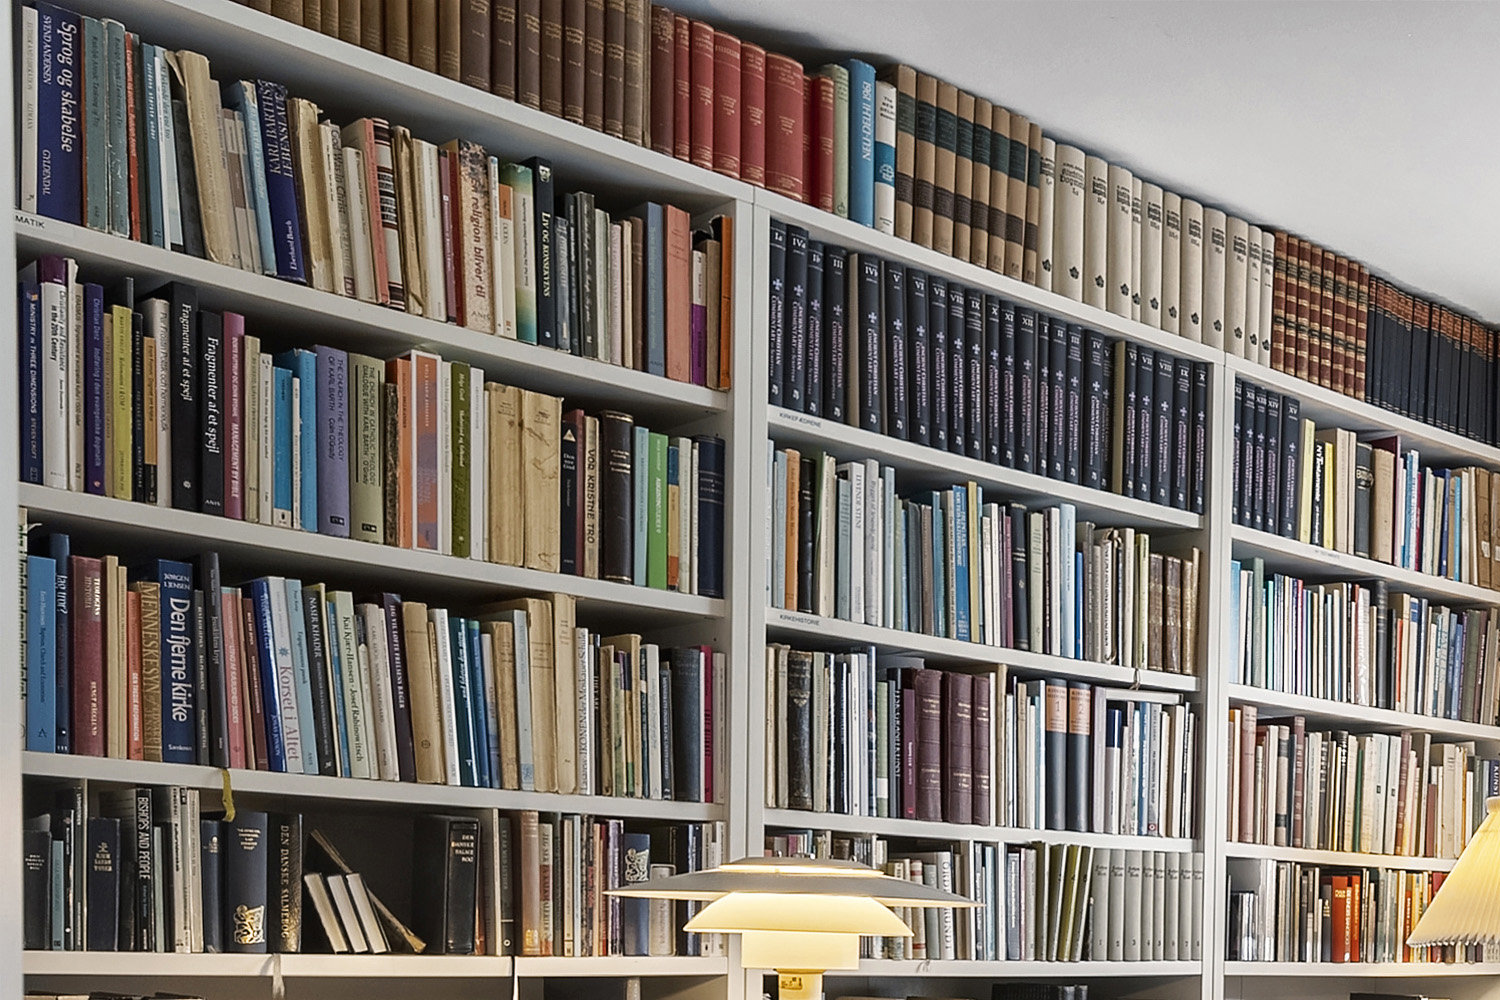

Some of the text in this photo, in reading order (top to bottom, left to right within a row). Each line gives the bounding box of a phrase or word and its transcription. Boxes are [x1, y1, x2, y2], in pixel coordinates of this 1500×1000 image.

[43, 15, 51, 84] SVEND ANDERSEN
[57, 21, 78, 152] Sprog og skabelse
[862, 81, 872, 162] NEU-DELHI 1961
[42, 150, 50, 195] GYLDENDAL
[469, 197, 484, 243] religion
[473, 247, 485, 281] bliver
[475, 285, 485, 297] til
[29, 303, 38, 336] MINISTRY
[180, 304, 192, 401] Fragmenter af et spejl
[206, 337, 219, 453] Fragmenter af et spejl
[231, 469, 239, 478] BY
[231, 479, 239, 498] BIBLE
[587, 449, 595, 544] VOR KRISTNE TRO
[141, 584, 159, 693] MENNESKESYN
[165, 597, 192, 722] Den fjerne kirke
[309, 597, 321, 658] NASER KHADER
[342, 616, 356, 683] Kai Kjær-Hansen
[279, 666, 297, 711] Korset
[285, 725, 300, 761] Altet
[348, 688, 364, 762] Josef Rabinowitsch
[137, 796, 150, 879] BISHOPS AND PEOPLE
[280, 825, 290, 938] DEN DANSKE SALMEBOG
